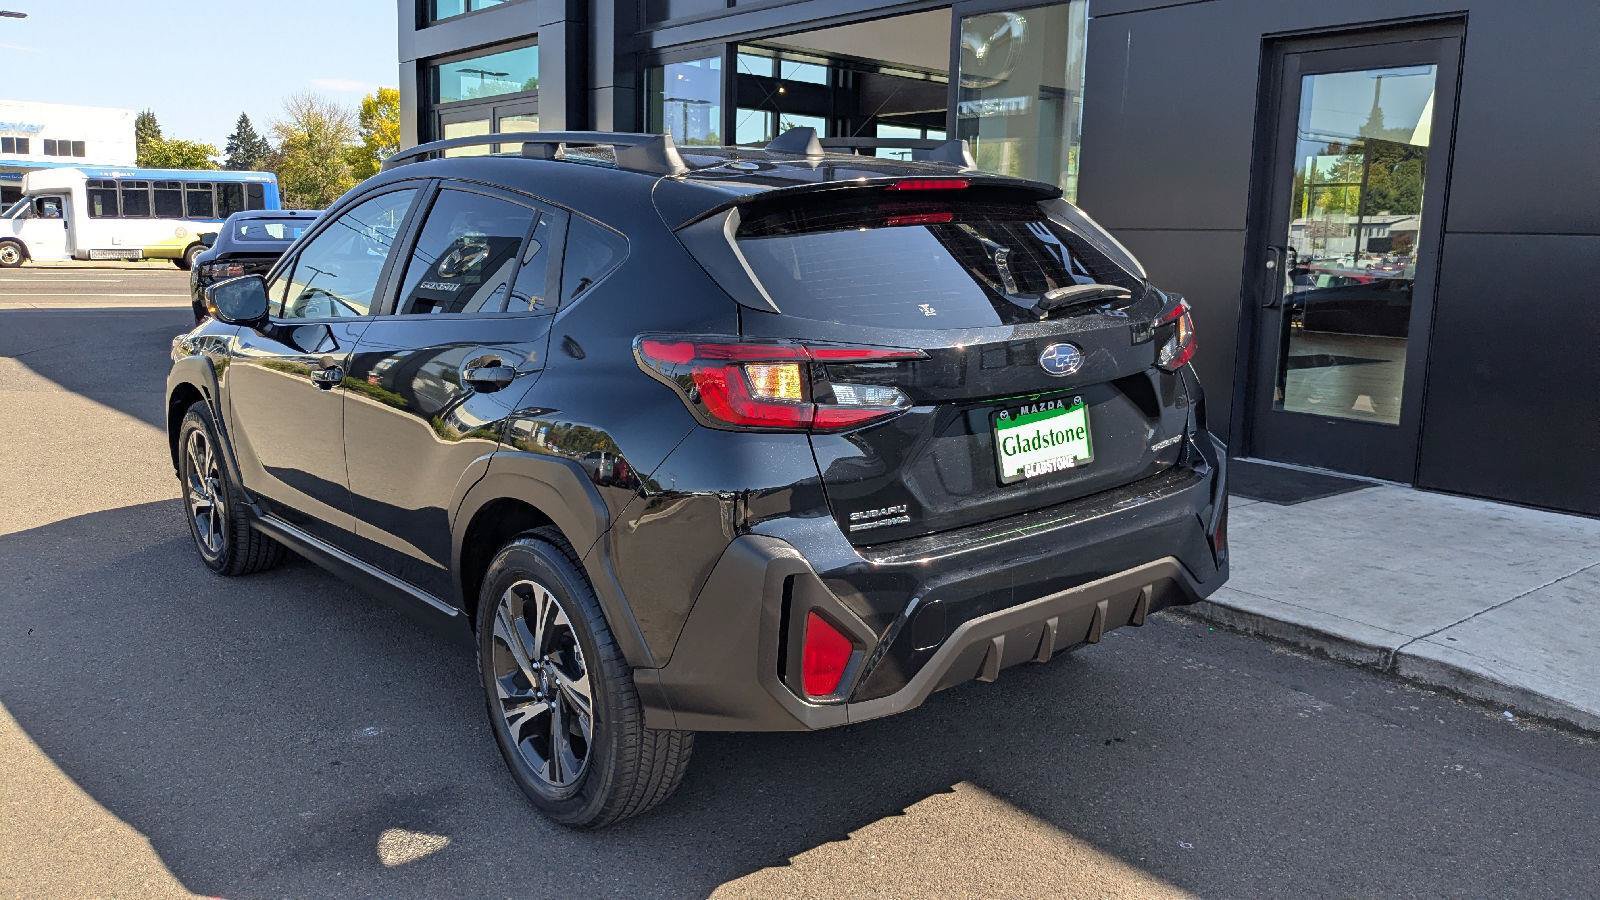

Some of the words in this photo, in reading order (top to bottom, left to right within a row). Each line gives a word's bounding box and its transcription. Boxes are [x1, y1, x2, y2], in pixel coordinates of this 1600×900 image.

[1020, 399, 1064, 415] MAZDA
[1002, 426, 1085, 456] Gladstone
[1024, 455, 1075, 478] GLADSTONE
[849, 504, 907, 520] SUBARU
